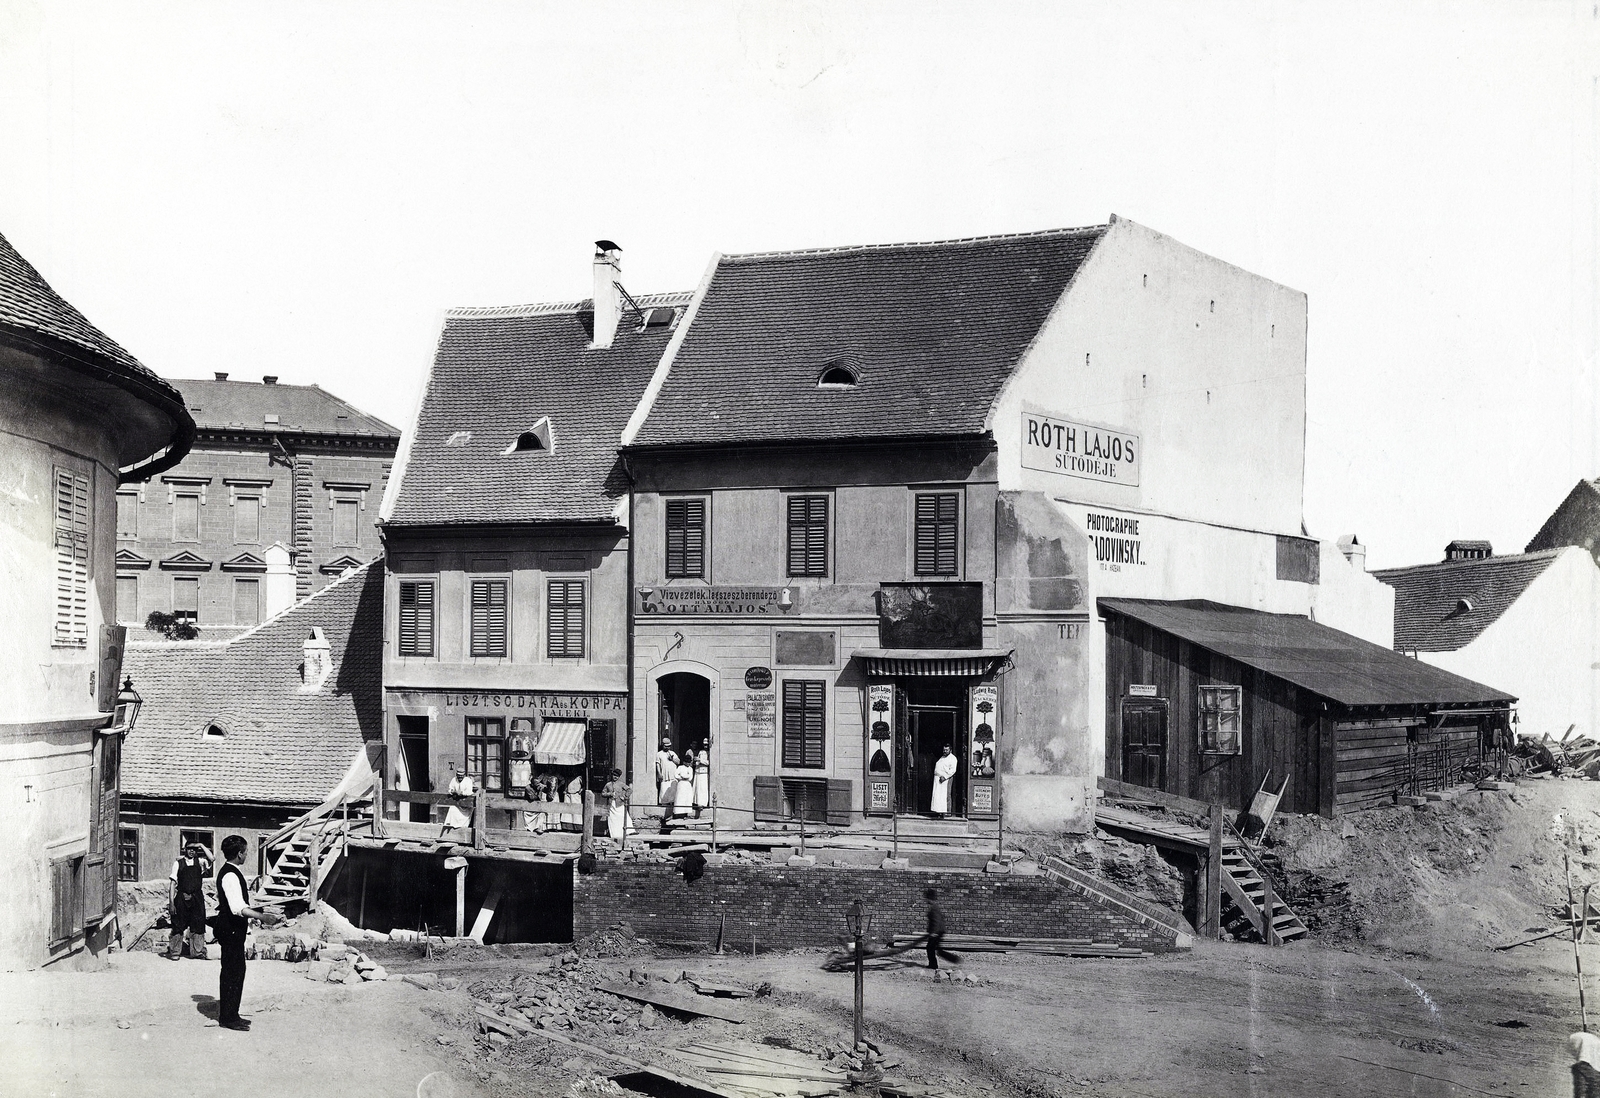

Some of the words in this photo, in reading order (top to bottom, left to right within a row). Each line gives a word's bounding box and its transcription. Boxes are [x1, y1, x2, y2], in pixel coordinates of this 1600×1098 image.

[1028, 418, 1076, 453] RÓTH
[1084, 430, 1134, 463] LAJOS
[667, 604, 700, 613] OTT
[517, 695, 560, 708] DARA
[872, 783, 887, 791] LISZT
